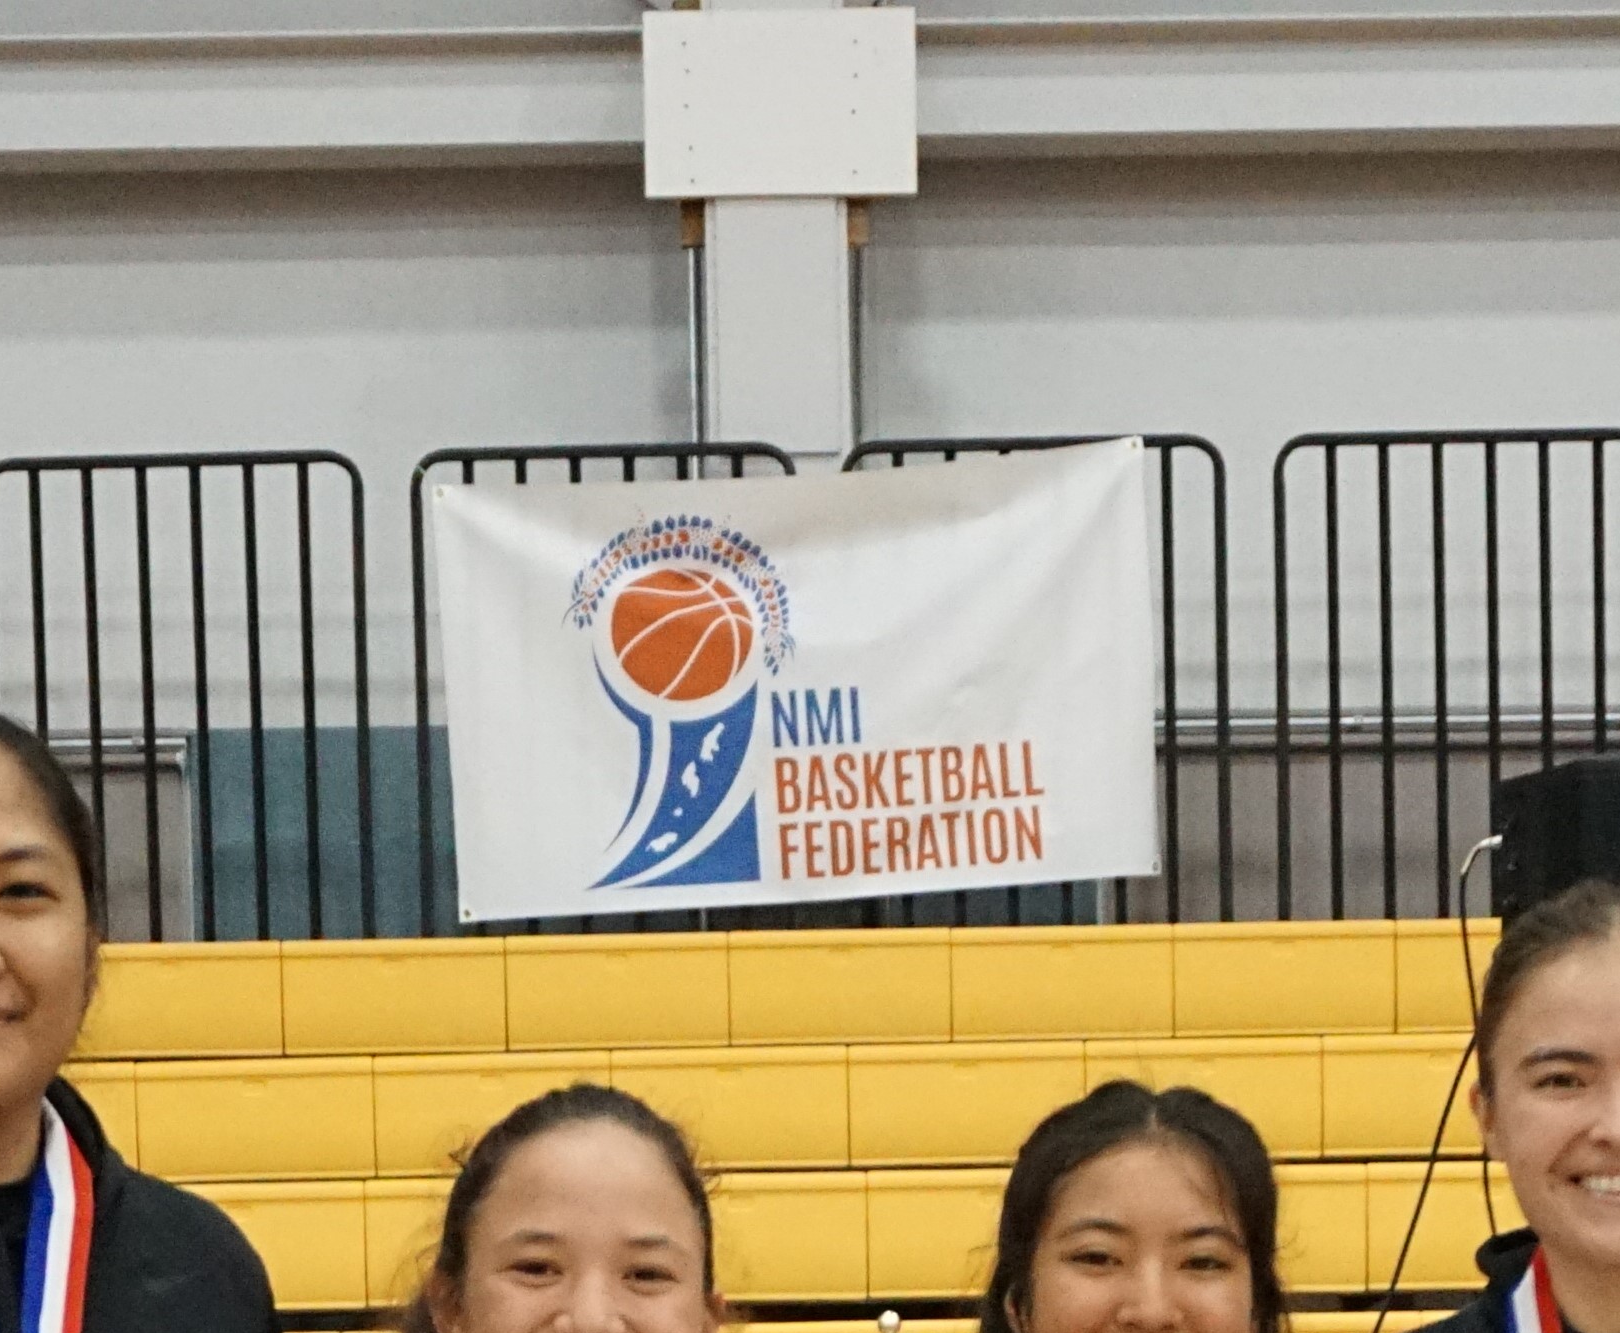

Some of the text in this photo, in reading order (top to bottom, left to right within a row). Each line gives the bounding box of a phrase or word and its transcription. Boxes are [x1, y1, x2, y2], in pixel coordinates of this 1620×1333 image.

[770, 686, 862, 748] NMI
[774, 740, 1045, 815] BASKETBALL
[778, 805, 1044, 880] FEDERATION
